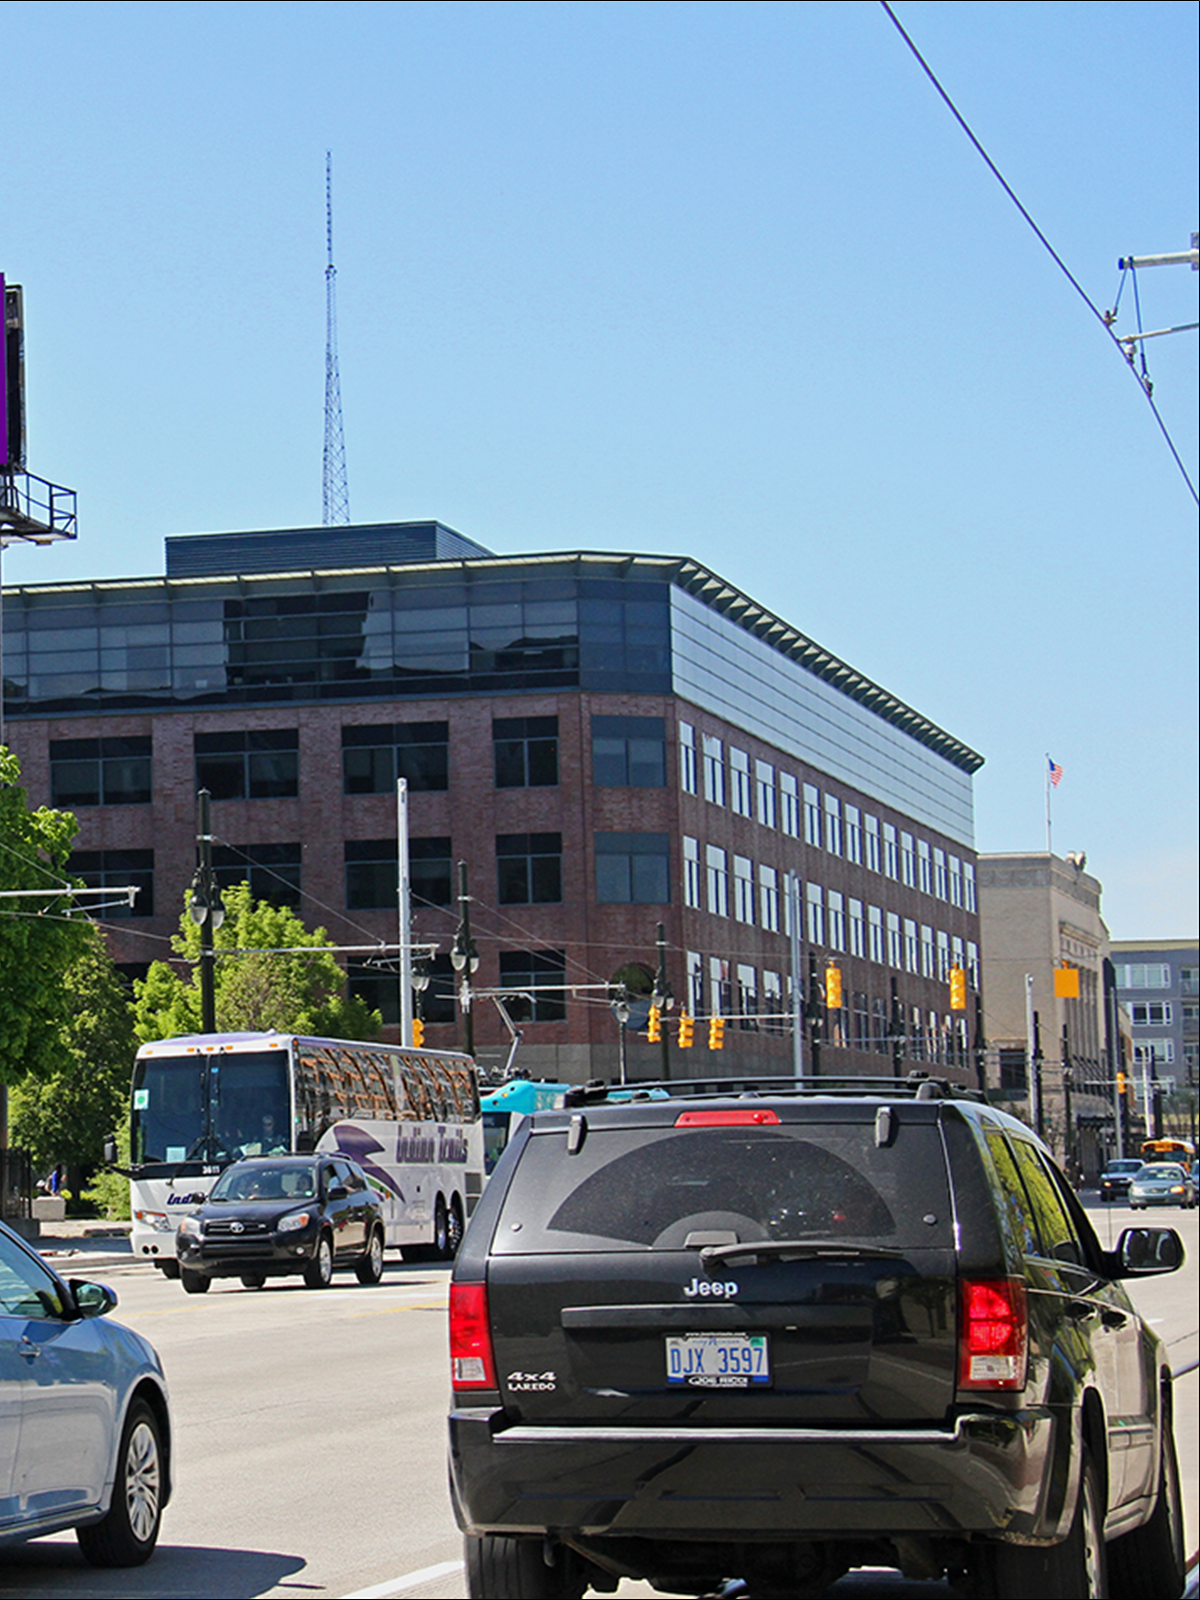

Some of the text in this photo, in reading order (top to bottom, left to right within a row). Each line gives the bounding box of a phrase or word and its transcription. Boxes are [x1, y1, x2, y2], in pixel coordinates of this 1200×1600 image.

[396, 1124, 468, 1164] Indian Trails
[683, 1278, 738, 1299] Jeep
[670, 1347, 763, 1374] DJX 3597
[507, 1371, 557, 1382] 4x4
[508, 1382, 556, 1392] LAREDO
